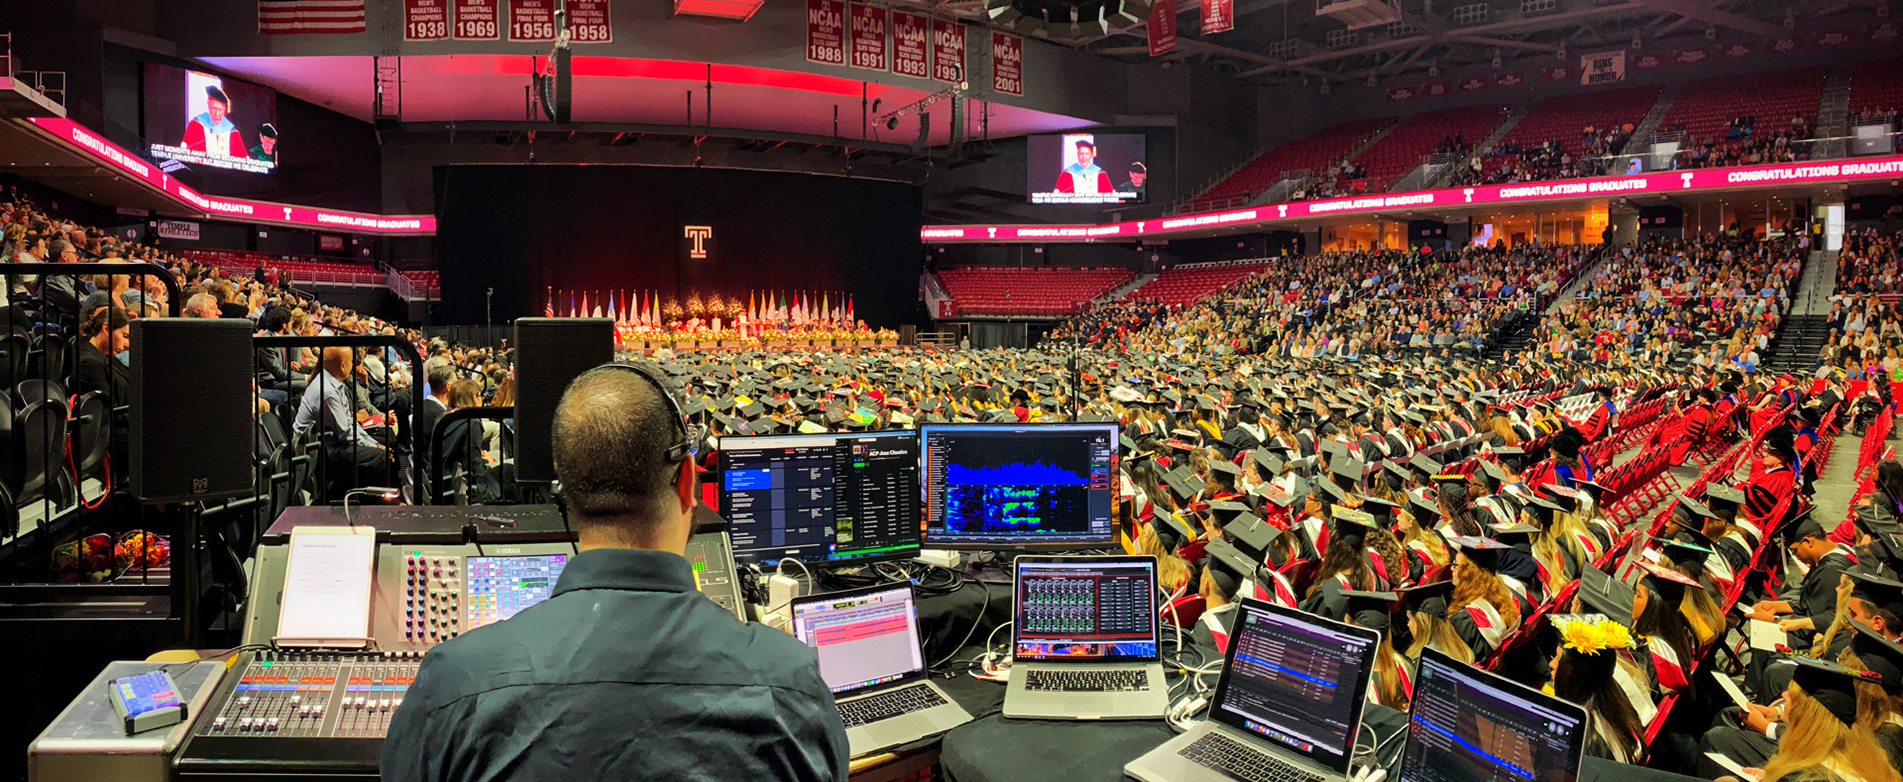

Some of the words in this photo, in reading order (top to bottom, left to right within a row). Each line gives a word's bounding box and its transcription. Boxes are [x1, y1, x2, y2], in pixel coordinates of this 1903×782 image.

[810, 8, 842, 28] NCAA
[853, 16, 884, 34] NCAA
[409, 22, 445, 37] 1938
[458, 22, 494, 36] 1969
[513, 23, 552, 38] 1956
[570, 25, 607, 40] 1958
[895, 23, 925, 42] NCAA
[935, 30, 963, 50] NCAA
[810, 45, 842, 62] 1988
[854, 52, 883, 68] 1991
[994, 44, 1020, 62] NCAA
[896, 58, 926, 75] 1993
[1594, 58, 1612, 68] RING
[995, 76, 1020, 92] 2001
[1589, 72, 1616, 83] HONOR
[73, 128, 123, 164] CONGRATULATIONS
[124, 155, 148, 177] GRADUATES
[151, 143, 164, 152] JUST
[165, 145, 191, 156] MOMENTS
[192, 150, 206, 158] AWAY
[151, 150, 172, 160] TEMPLE
[1728, 164, 1839, 182] CONGRATULATIONS
[1500, 183, 1586, 198] CONGRATULATIONS
[1589, 179, 1646, 192] GRADUATES
[210, 200, 253, 214] GRADUATES
[1309, 198, 1384, 213] CONGRATULATIONS
[1385, 194, 1434, 207] GRADUATES
[318, 214, 376, 228] CONGRATULATIONS
[378, 220, 420, 228] GRADUATES
[1162, 215, 1218, 229] CONGRATULATIONS
[1219, 210, 1256, 222] GRADUATES
[159, 228, 198, 237] ATHLETICS
[1017, 228, 1086, 237] CONGRATULATIONS
